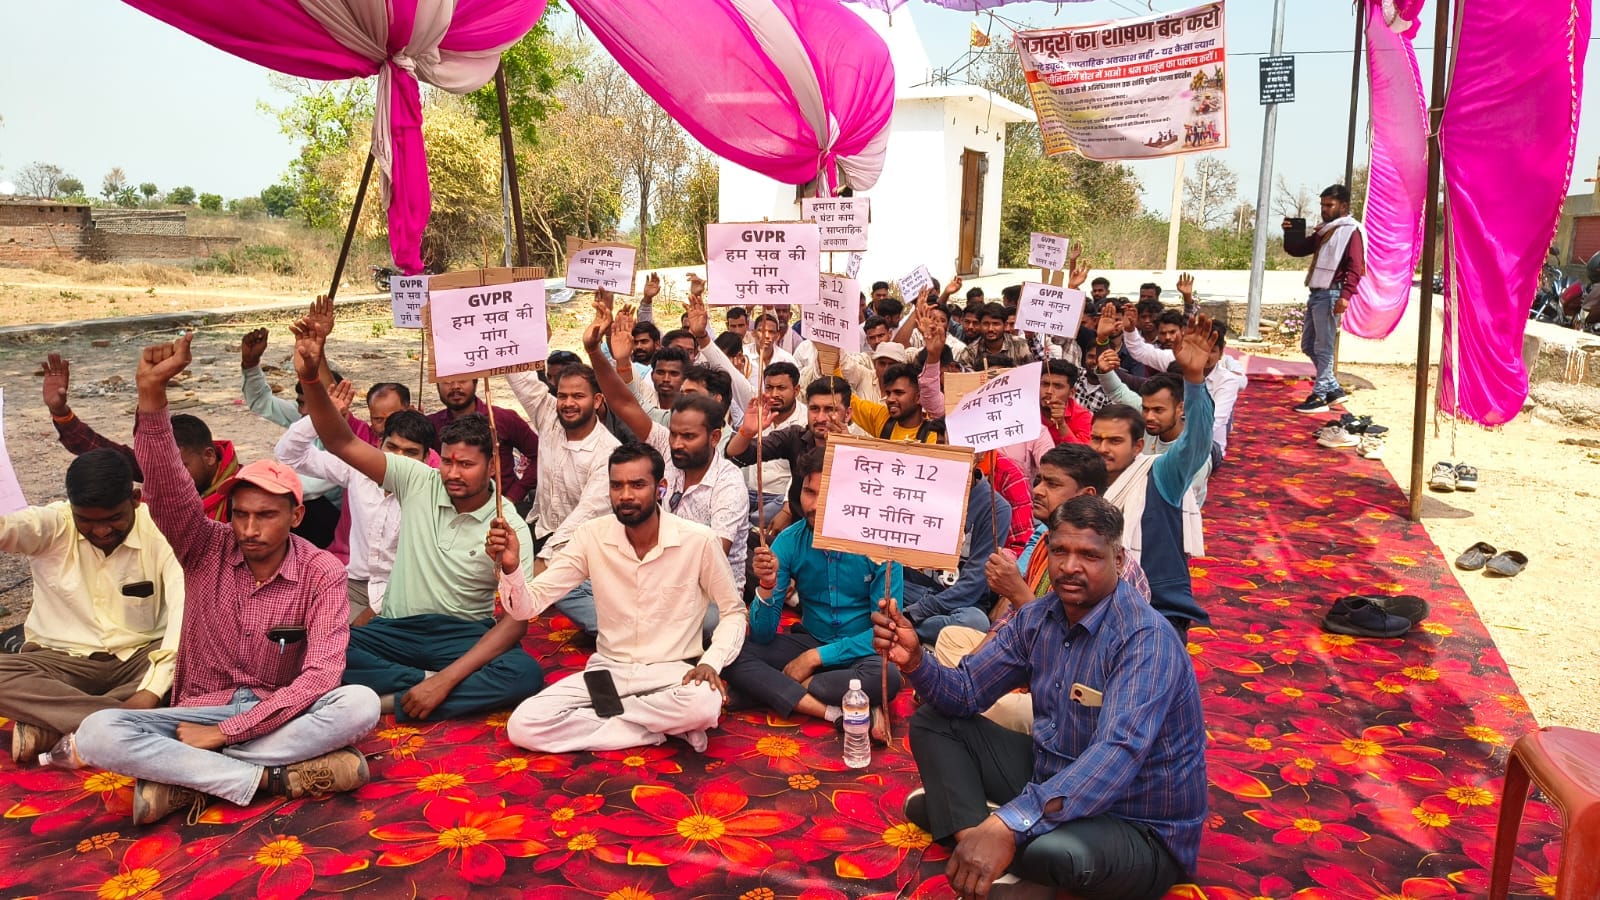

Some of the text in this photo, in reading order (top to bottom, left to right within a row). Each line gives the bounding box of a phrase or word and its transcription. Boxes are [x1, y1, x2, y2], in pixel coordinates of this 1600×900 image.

[1074, 31, 1098, 49] का
[1157, 15, 1183, 37] बंद
[1186, 6, 1220, 29] करो
[1106, 53, 1137, 64] अवकाश
[1138, 48, 1155, 60] नहीं
[812, 201, 853, 212] हमारा हक
[838, 214, 854, 222] काम
[741, 230, 786, 243] GVPR
[826, 225, 862, 235] साप्ताहिक
[588, 249, 614, 257] GVPR
[725, 249, 748, 263] हम
[787, 245, 806, 261] की
[579, 257, 594, 266] श्रम
[594, 268, 605, 276] का
[751, 264, 778, 277] मांग
[399, 279, 423, 288] GVPR
[577, 276, 618, 288] पालन करो
[831, 279, 844, 294] 12
[735, 279, 789, 299] पुरी करो
[1039, 288, 1064, 299] GVPR
[394, 291, 404, 301] हम
[468, 290, 513, 307] GVPR
[823, 297, 839, 309] काम
[1030, 298, 1045, 308] श्रम
[400, 312, 412, 325] पुरी
[451, 314, 475, 331] हम
[515, 303, 534, 320] की
[818, 311, 836, 326] नीति
[839, 318, 849, 330] का
[1043, 310, 1053, 318] का
[1025, 319, 1064, 332] पालन करो
[480, 327, 508, 342] मांग
[811, 327, 841, 343] अपमान
[463, 340, 520, 367] पुरी करो
[986, 409, 1002, 422] का
[964, 420, 1024, 445] पालन करो
[853, 455, 938, 482] दिन के 12
[859, 477, 927, 503] घंटे काम
[842, 504, 944, 529] श्रम नीति का
[860, 526, 921, 546] अपमान
